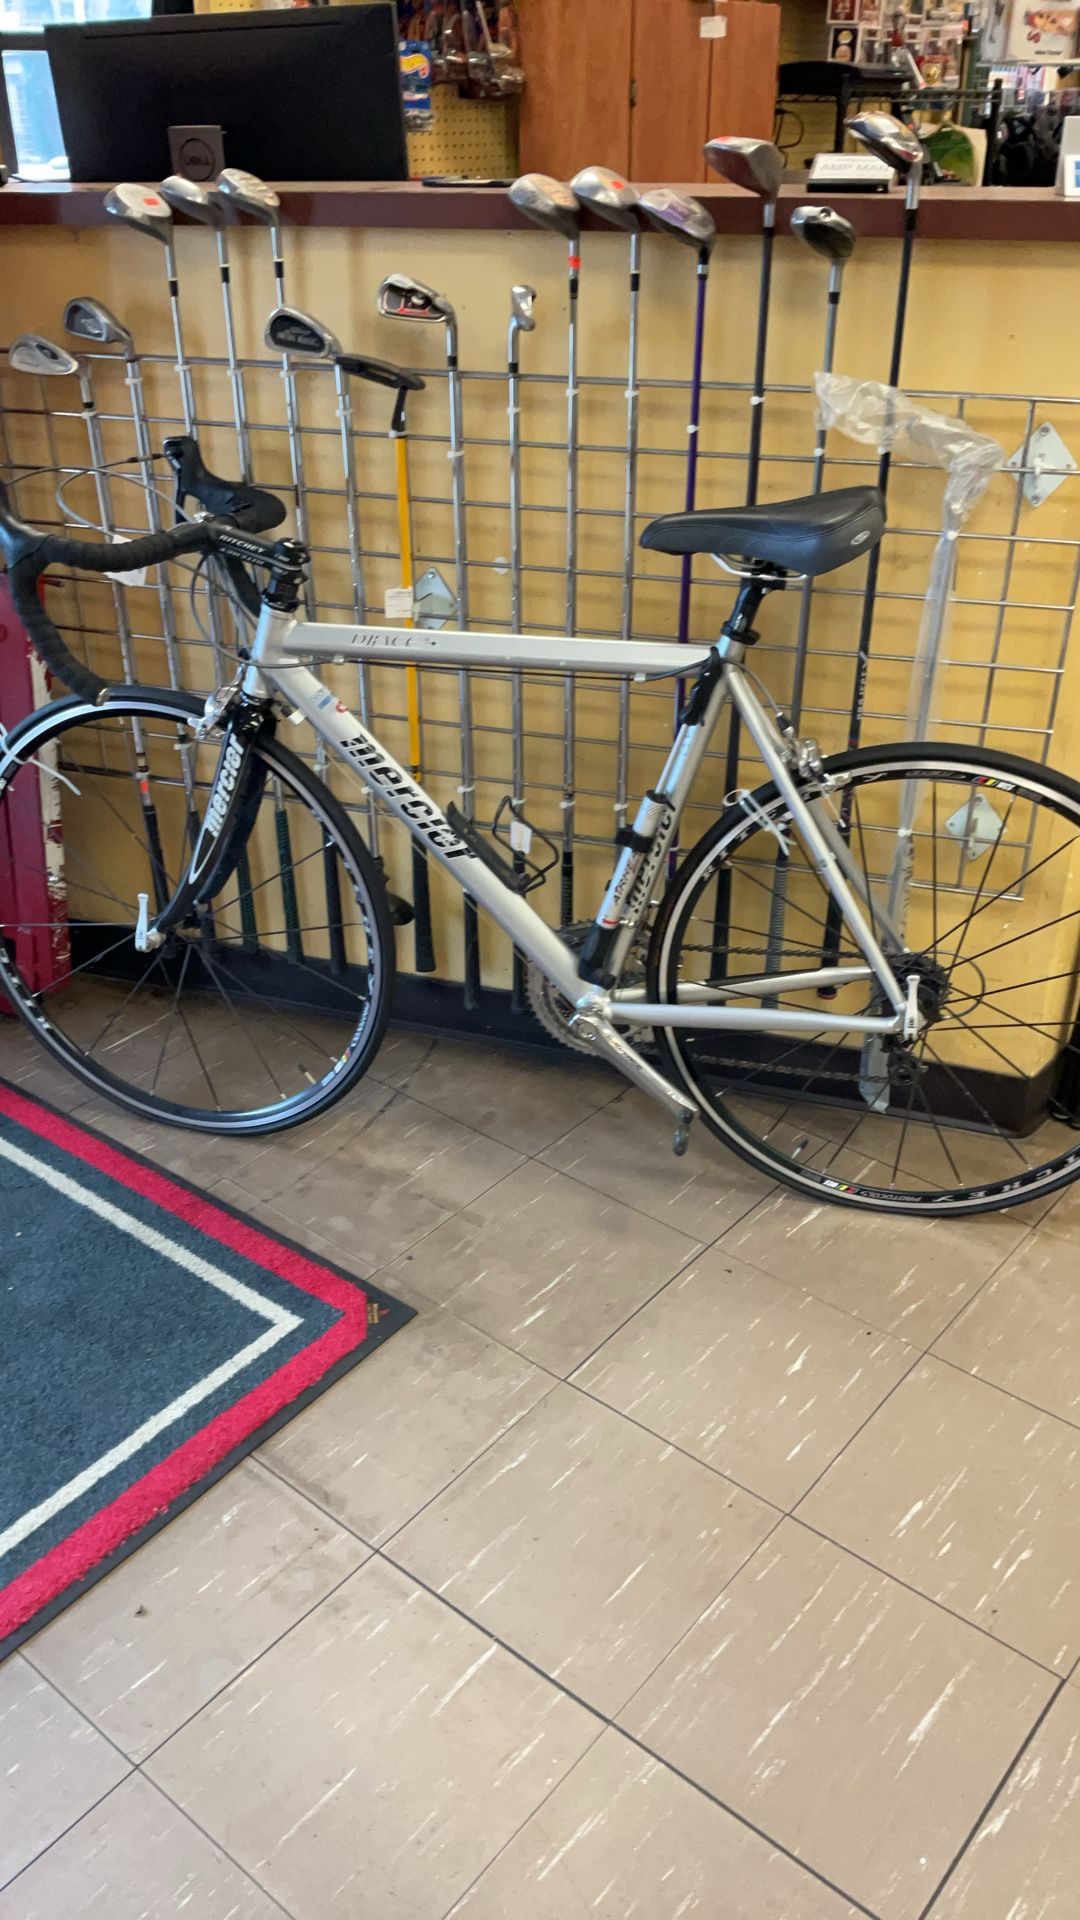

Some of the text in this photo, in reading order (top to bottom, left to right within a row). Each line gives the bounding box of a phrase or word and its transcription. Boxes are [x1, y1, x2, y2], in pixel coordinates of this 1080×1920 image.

[218, 534, 267, 554] RITCHEY
[205, 733, 244, 838] mercier
[339, 733, 479, 860] mercier
